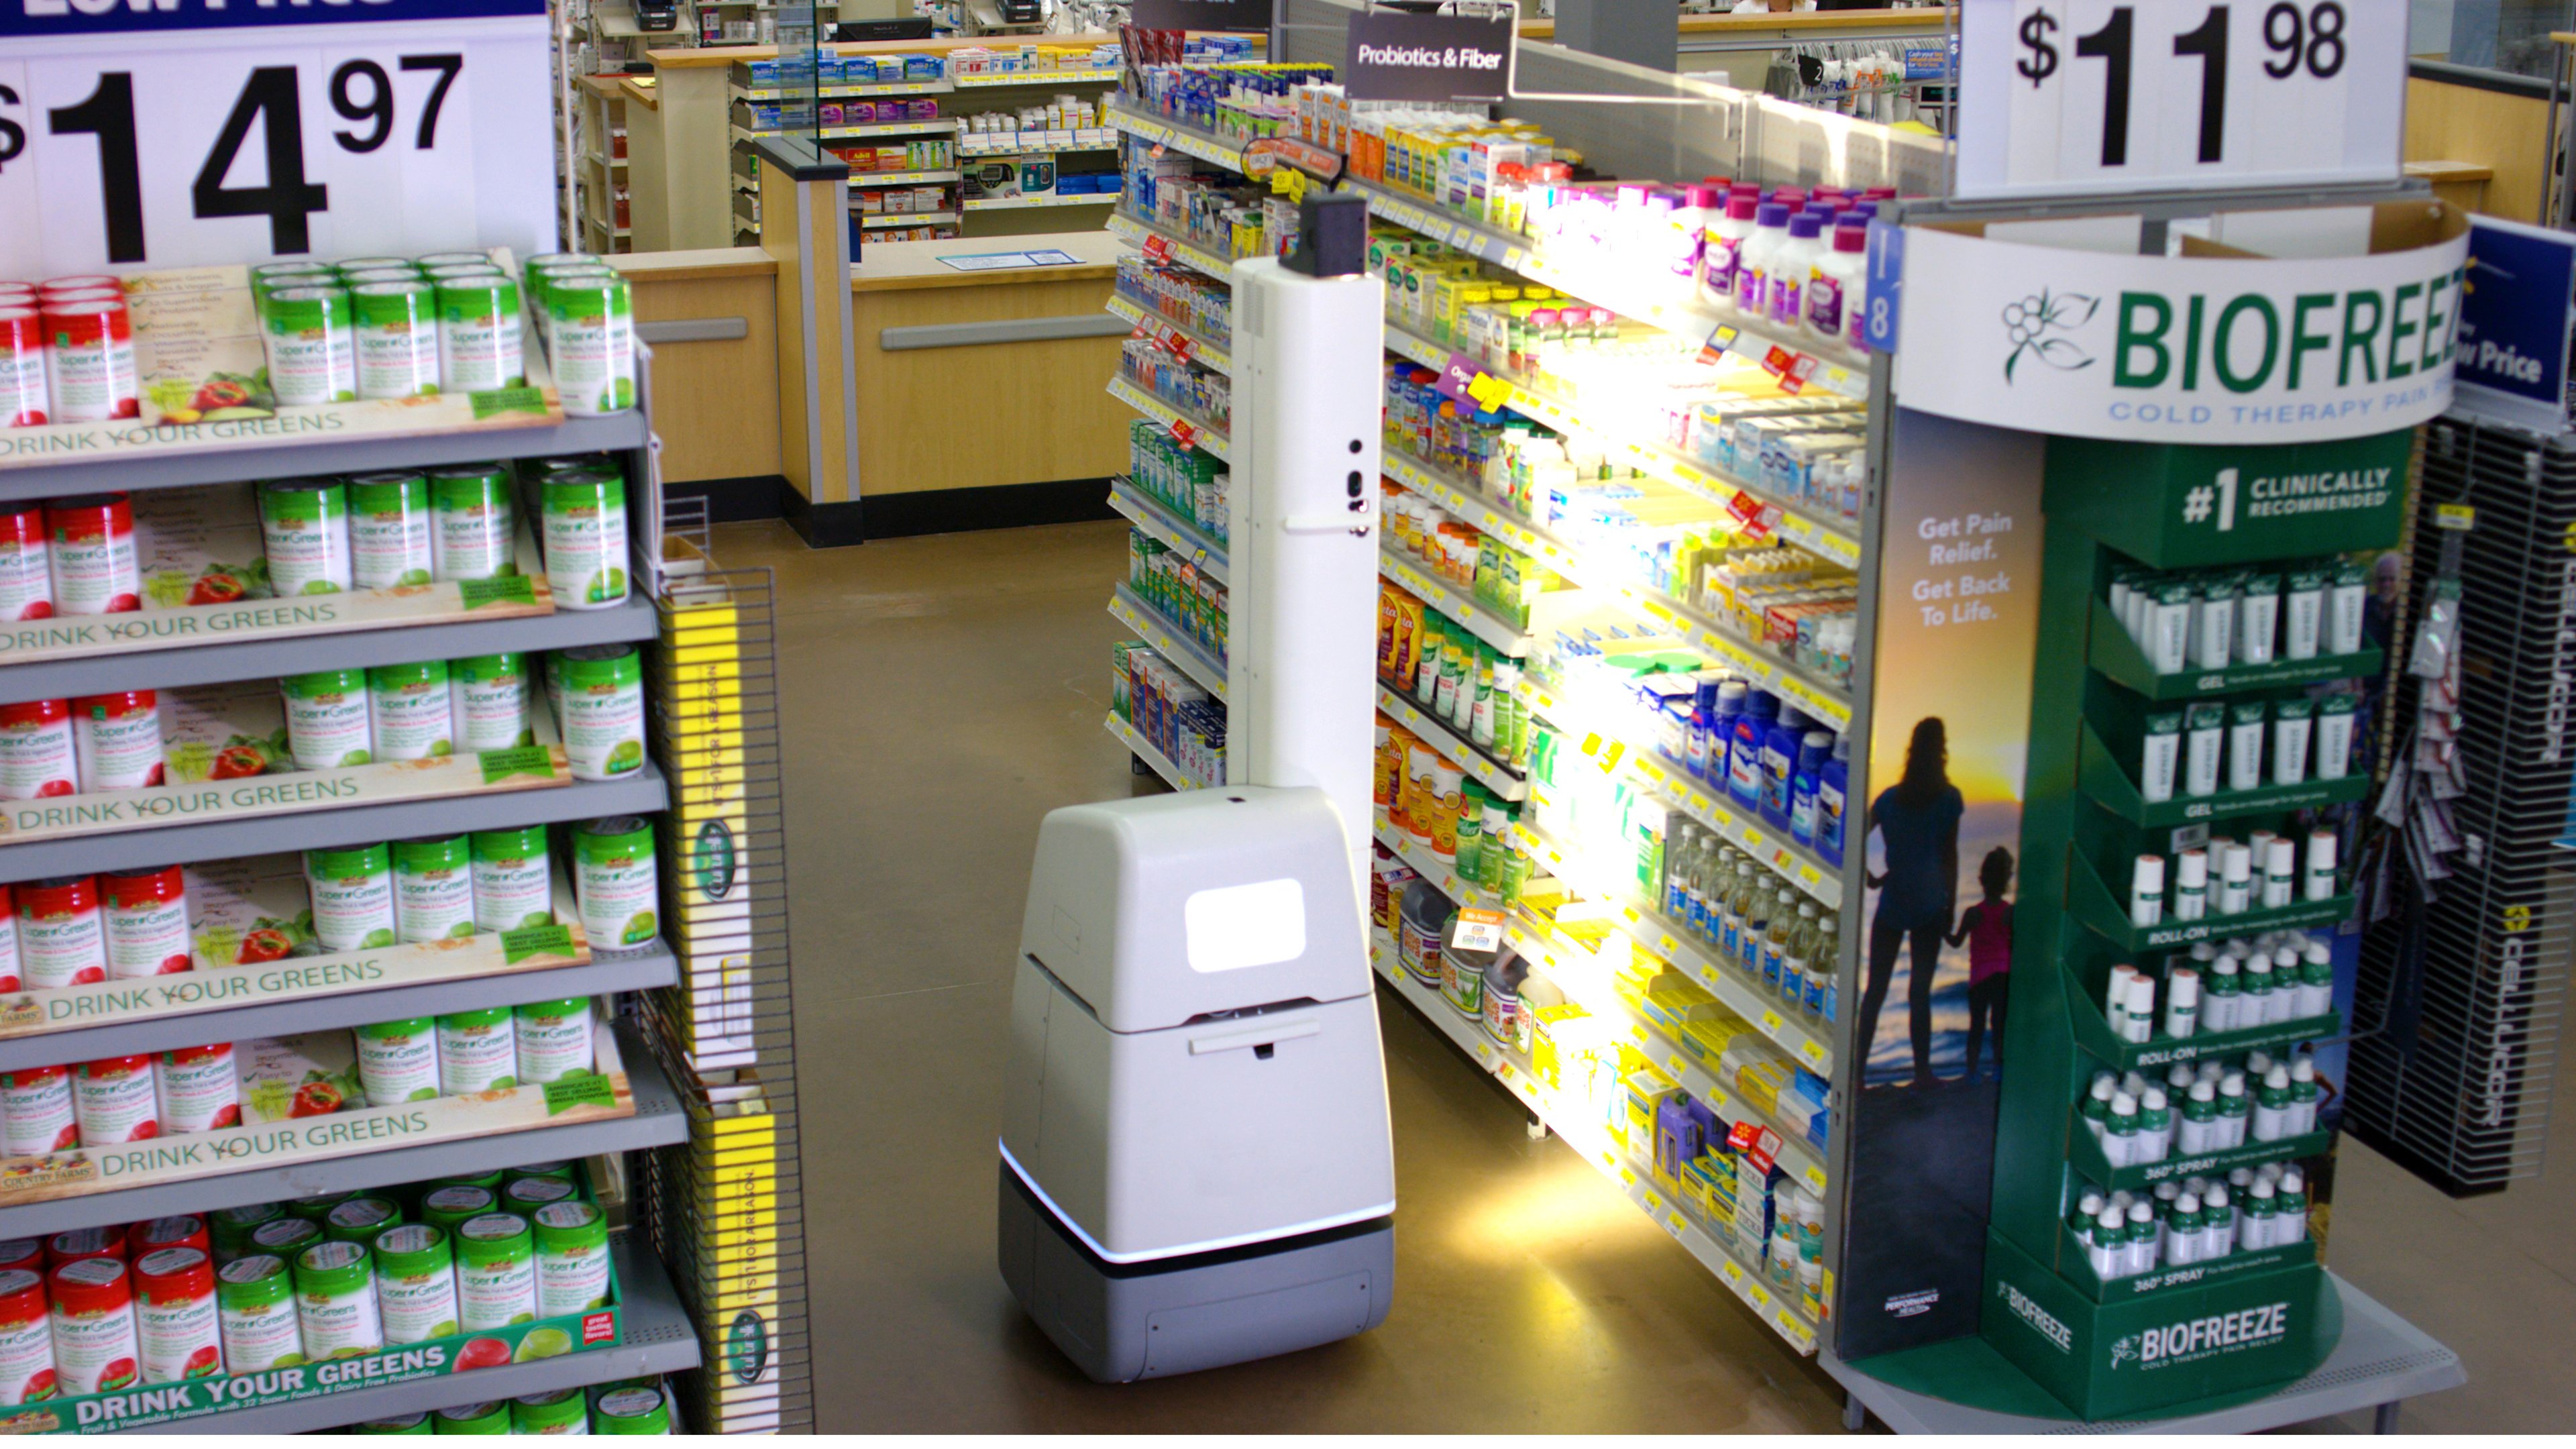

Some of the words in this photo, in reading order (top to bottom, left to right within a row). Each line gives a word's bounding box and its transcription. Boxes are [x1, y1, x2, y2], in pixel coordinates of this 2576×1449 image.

[1358, 44, 1440, 66] Probiotics
[1444, 48, 1456, 65] &
[1460, 49, 1502, 70] Fiber
[1871, 297, 1888, 339] 8
[2479, 340, 2542, 384] Price
[2108, 402, 2212, 424] COLD
[2232, 398, 2371, 424] THERAPY
[2383, 390, 2428, 411] PAIN
[106, 422, 200, 445] YOUR
[211, 412, 343, 437] GREENS
[2183, 468, 2239, 532] #1
[2249, 468, 2392, 499] CLINICALLY
[1918, 517, 1960, 539] Get
[1966, 513, 2012, 535] Pain
[1930, 538, 1997, 566] Relief.
[1913, 579, 1953, 601] Get
[1960, 572, 2010, 596] Back
[105, 616, 197, 639] YOUR
[207, 603, 336, 631] GREENS
[1920, 606, 1945, 627] To
[1952, 600, 1998, 623] Life.
[2197, 675, 2225, 690] GEL
[17, 801, 123, 830] DRINK
[130, 791, 221, 816] YOUR
[231, 776, 358, 807] GREENS
[2185, 803, 2212, 818] GEL
[1465, 912, 1477, 920] We
[1477, 913, 1498, 922] Accept
[2148, 926, 2209, 946] ROLL-ON
[49, 987, 153, 1022] DRINK
[158, 976, 250, 1004] YOUR
[258, 958, 384, 992] GREENS
[2485, 937, 2524, 1128] CELLUCOR
[2137, 1046, 2197, 1067] ROLL-ON
[101, 1144, 203, 1177] DRINK
[208, 1130, 298, 1160] YOUR
[305, 1110, 429, 1147] GREENS
[2177, 1158, 2218, 1175] SPRAY
[2165, 1269, 2206, 1286] SPRAY
[585, 1322, 612, 1334] tasting
[588, 1314, 608, 1326] great
[2008, 1285, 2072, 1350] BIOFREEZE
[2141, 1303, 2288, 1361] BIOFREEZE
[2141, 1360, 2169, 1371] COLD
[2174, 1350, 2219, 1364] THERAPY
[2223, 1344, 2246, 1354] PAIN
[2250, 1336, 2284, 1348] RELIEF
[75, 1387, 193, 1426] DRINK
[203, 1368, 305, 1403] YOUR
[315, 1346, 446, 1385] GREENS
[81, 1420, 104, 1434] Fruit
[107, 1419, 117, 1431] &
[118, 1411, 171, 1433] Vegetable
[172, 1404, 214, 1421] Formula
[216, 1399, 239, 1414] with
[242, 1397, 256, 1409] 32
[258, 1393, 287, 1409] Super
[288, 1388, 315, 1403] Foods
[318, 1387, 329, 1399] &
[334, 1381, 362, 1397] Dairy
[365, 1376, 386, 1389] Free
[388, 1368, 436, 1383] Probiotics
